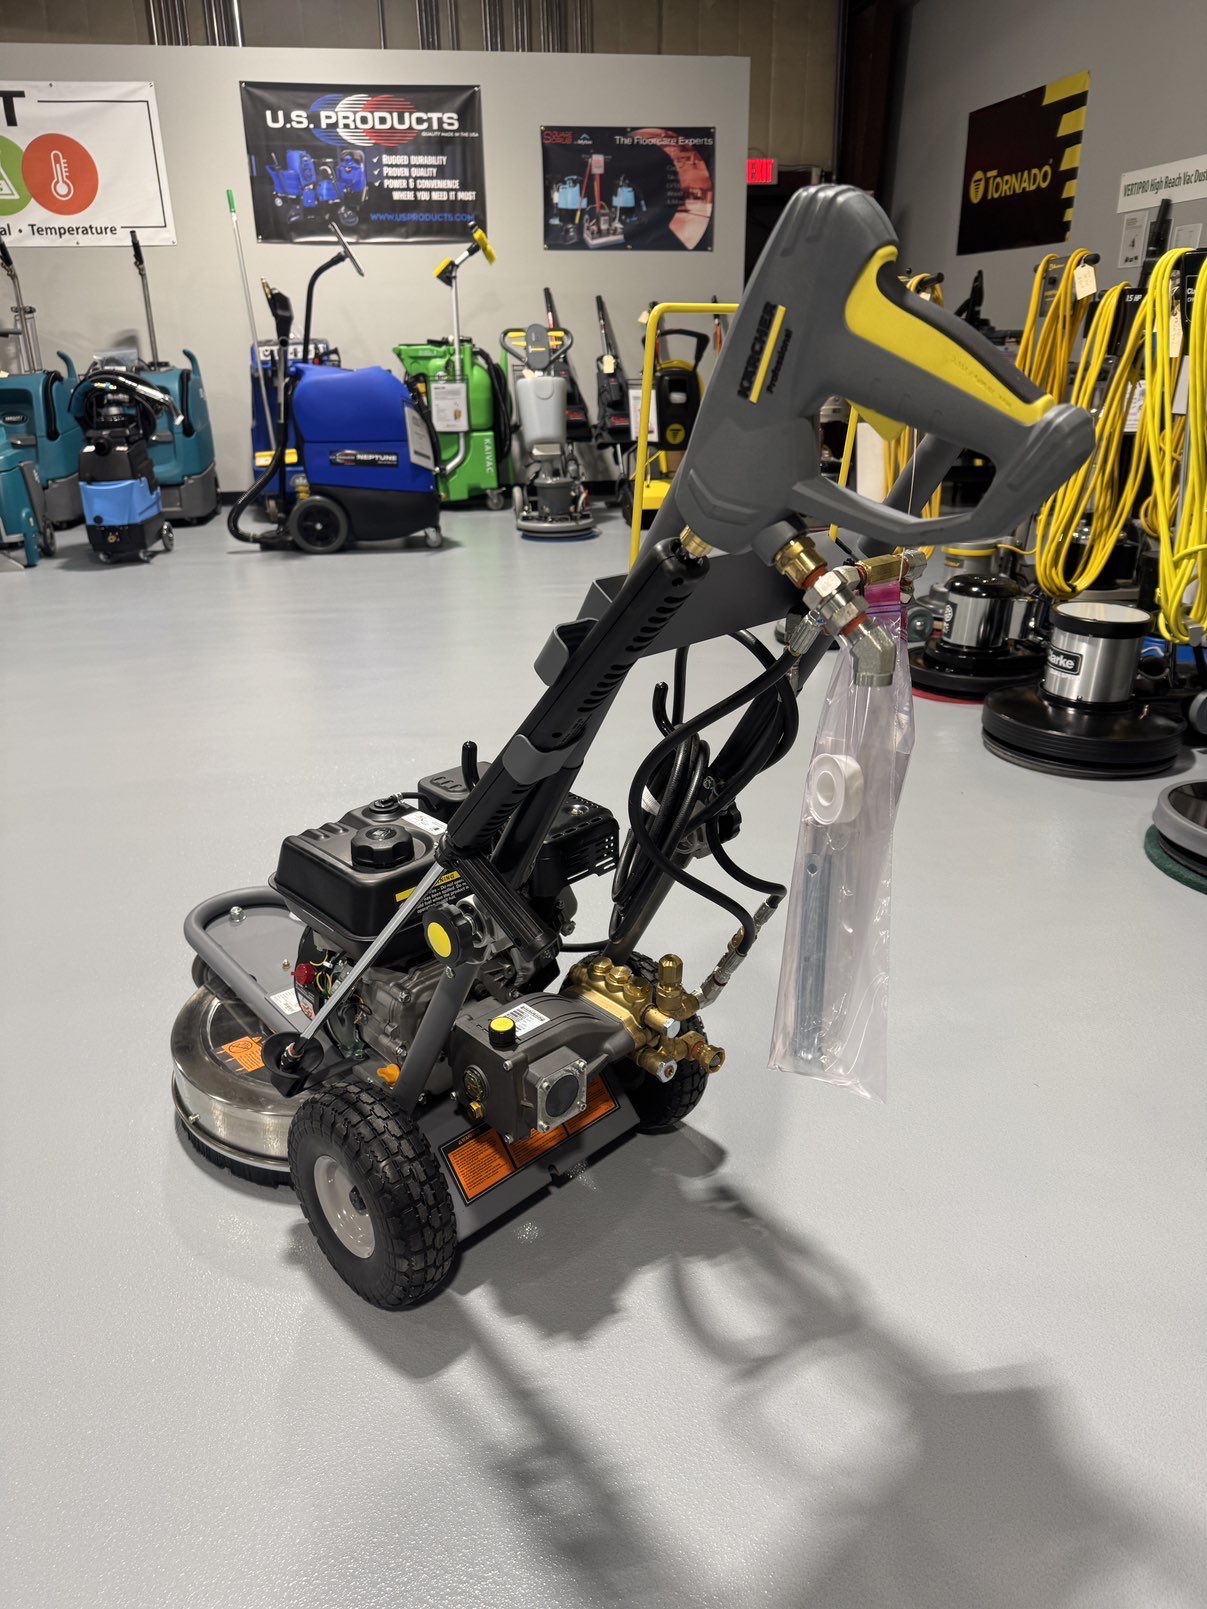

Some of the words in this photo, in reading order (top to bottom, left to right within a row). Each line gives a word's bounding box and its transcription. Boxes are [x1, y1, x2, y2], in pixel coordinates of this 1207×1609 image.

[266, 110, 314, 128] U.S.
[320, 111, 459, 130] PRODUCTS
[614, 136, 632, 145] The
[634, 136, 676, 145] Floorcare
[678, 136, 713, 146] Experts
[382, 155, 409, 165] RUGGED
[410, 156, 447, 165] DURABILITY
[383, 166, 409, 177] PROVEN
[411, 168, 438, 177] QUALITY
[747, 159, 774, 182] EXIT
[383, 179, 407, 188] POWER
[416, 180, 459, 189] CONVENIENCE
[986, 165, 1052, 200] TORNADO
[1124, 180, 1149, 197] VERTIPRO
[1150, 176, 1164, 194] High
[1164, 172, 1182, 190] Reach
[1182, 170, 1194, 186] Vac
[392, 191, 415, 200] WHERE
[416, 191, 430, 200] YOU
[431, 191, 448, 200] NEED
[449, 191, 456, 200] IT
[457, 191, 476, 201] MOST
[28, 224, 117, 238] Temperature
[766, 328, 792, 394] Professional
[356, 453, 397, 462] NEPTUNE
[484, 438, 494, 473] KAIVAC
[1048, 649, 1074, 669] larke
